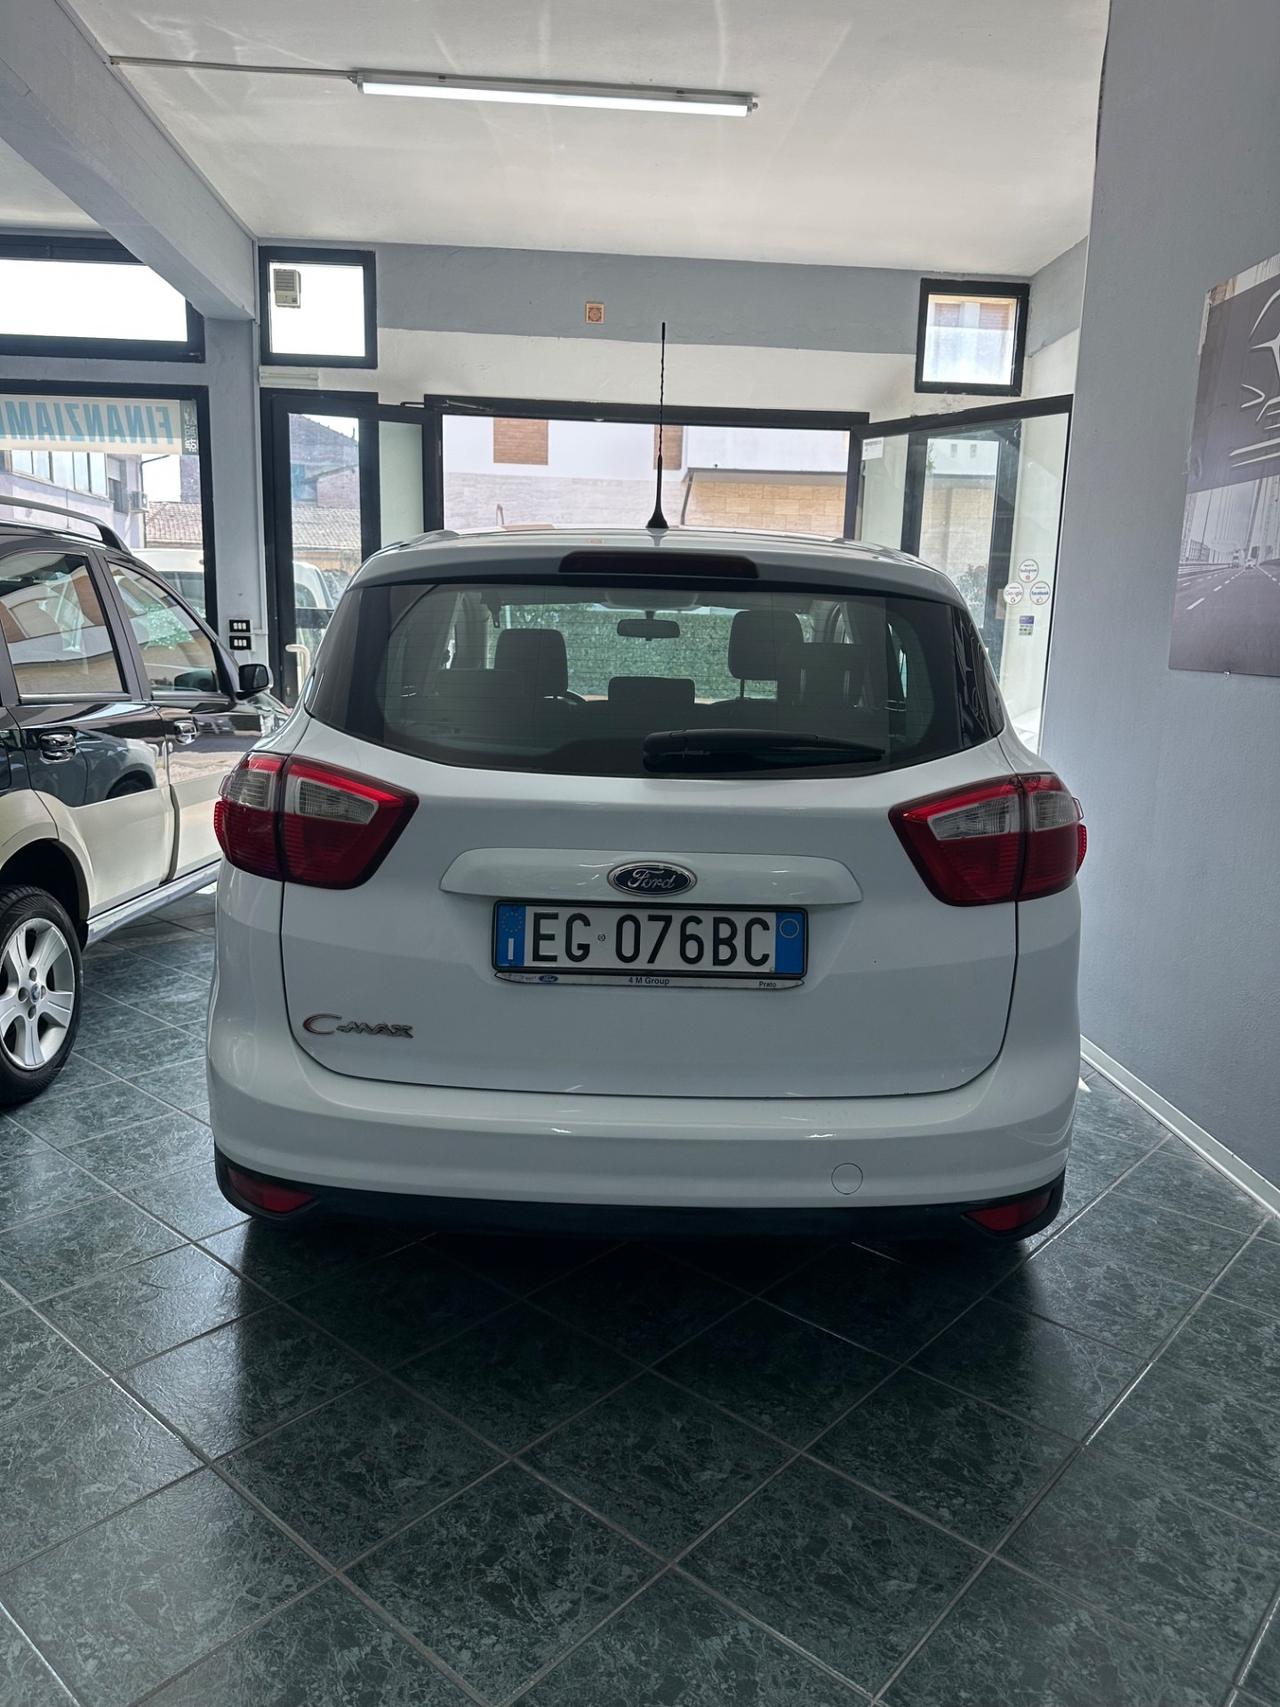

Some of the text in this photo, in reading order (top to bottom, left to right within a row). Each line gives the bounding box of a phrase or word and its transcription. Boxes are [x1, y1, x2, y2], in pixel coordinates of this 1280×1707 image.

[627, 868, 675, 889] Ford
[532, 911, 770, 967] EG 076BC
[628, 976, 670, 986] 4 M Group
